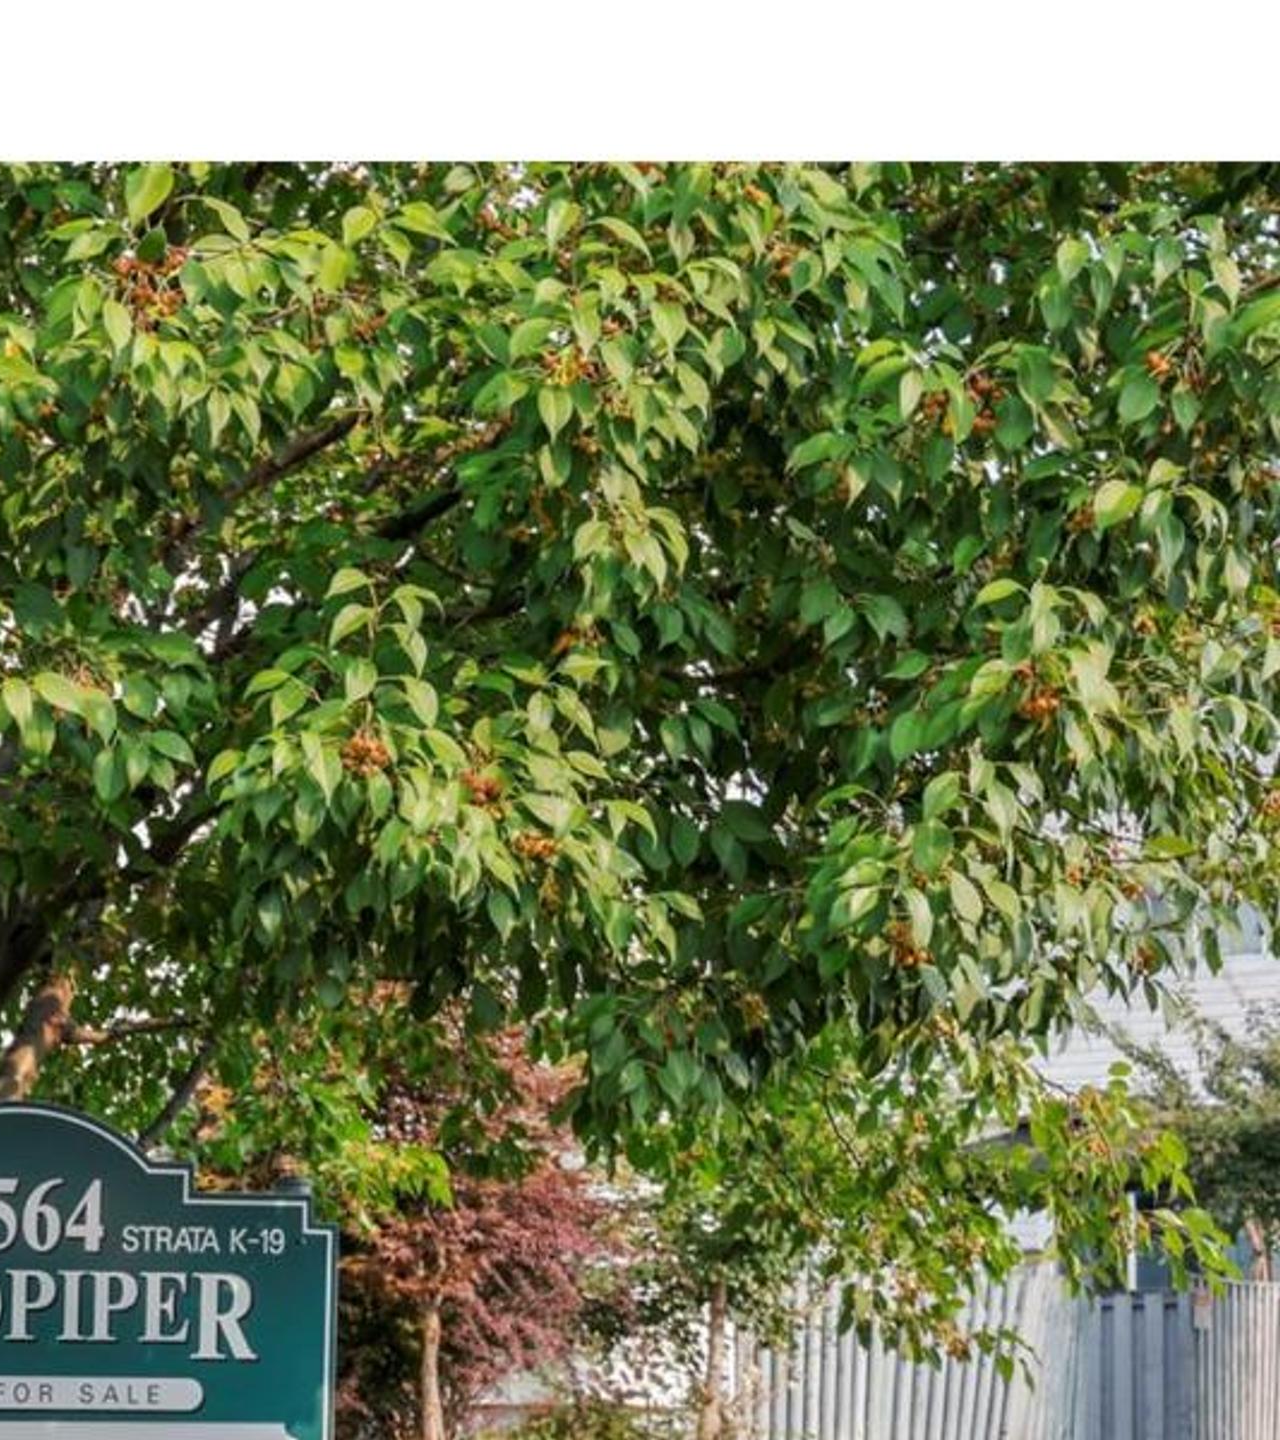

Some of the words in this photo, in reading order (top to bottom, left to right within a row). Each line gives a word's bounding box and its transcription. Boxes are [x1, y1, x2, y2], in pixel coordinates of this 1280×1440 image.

[121, 1224, 221, 1255] STRATA
[229, 1227, 286, 1256] K-19
[78, 1382, 162, 1406] SALE
